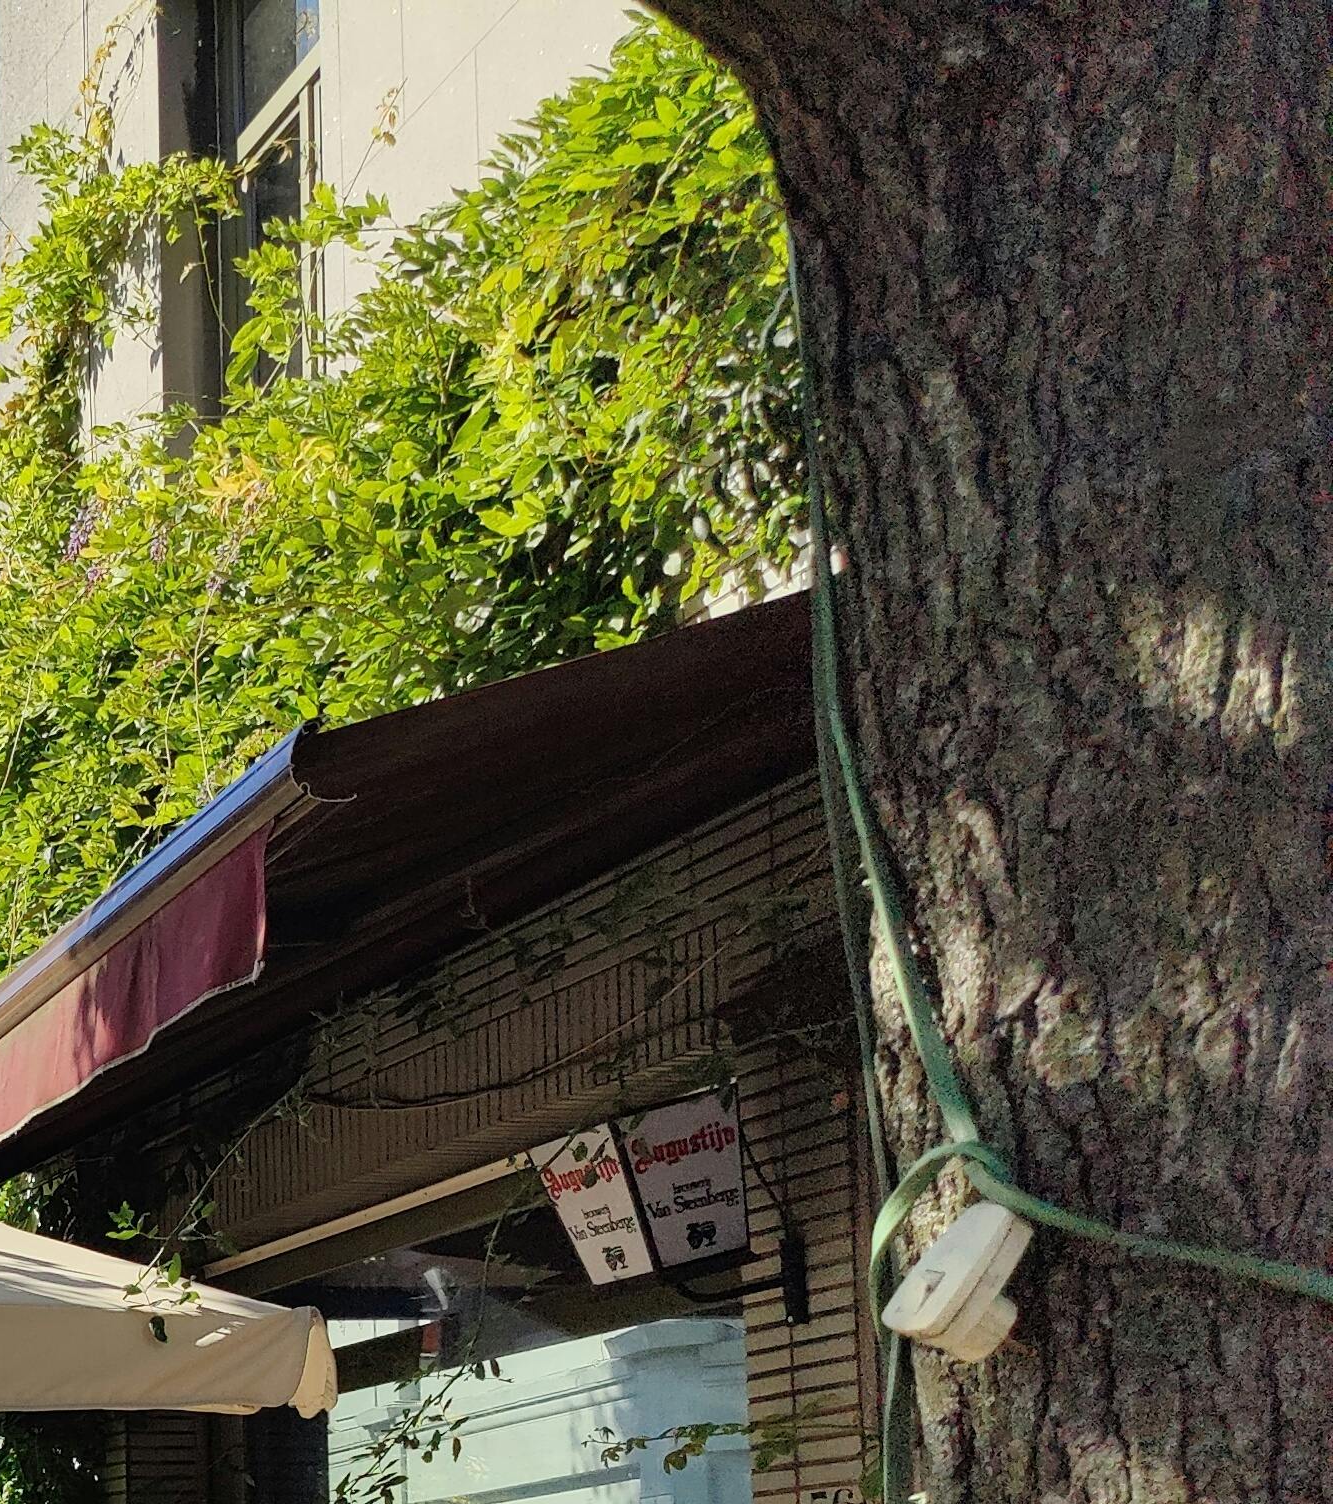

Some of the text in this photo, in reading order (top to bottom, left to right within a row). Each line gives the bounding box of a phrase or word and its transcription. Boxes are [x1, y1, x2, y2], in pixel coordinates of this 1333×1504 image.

[542, 1155, 620, 1200] Auguijn
[646, 1200, 671, 1218] Van
[568, 1224, 588, 1241] Van
